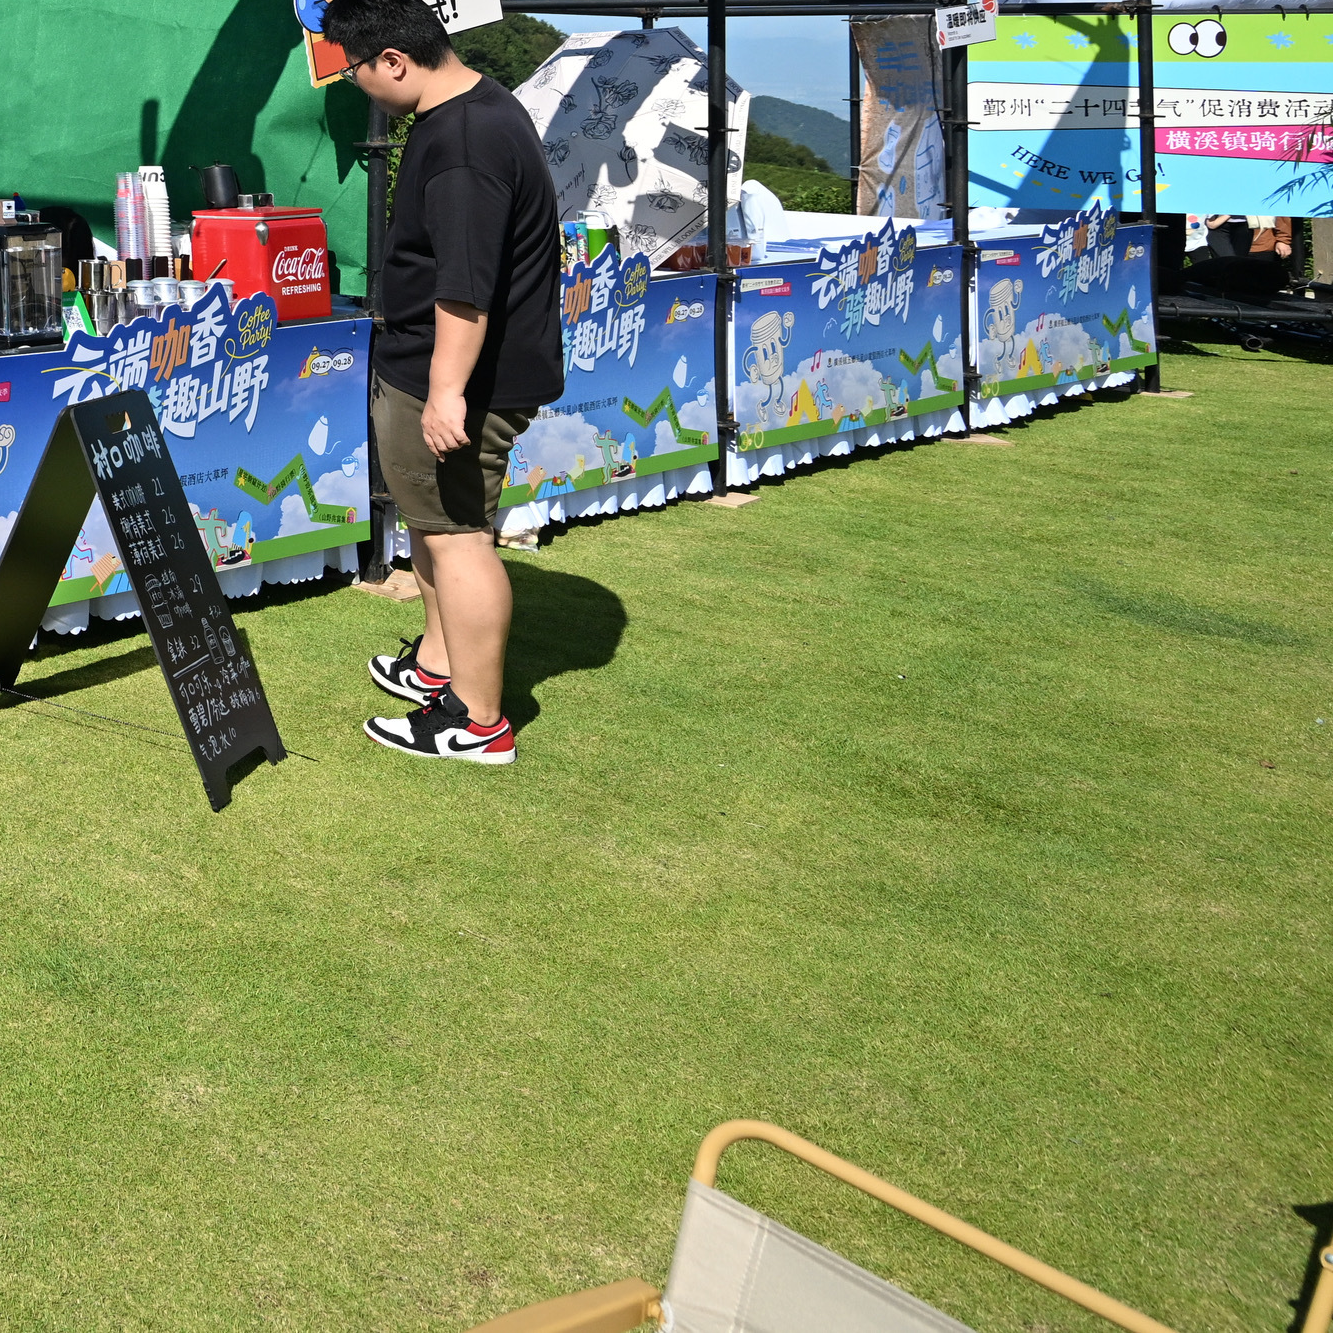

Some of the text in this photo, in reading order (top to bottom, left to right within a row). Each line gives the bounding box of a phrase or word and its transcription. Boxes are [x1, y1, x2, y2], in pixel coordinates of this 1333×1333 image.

[1011, 145, 1165, 185] HERE WE G!
[624, 262, 647, 284] Coffee
[811, 226, 895, 310] 云端咖香
[282, 283, 322, 295] REFRESHING
[560, 254, 616, 326] 咖香
[840, 269, 915, 341] 骑趣山野
[238, 307, 271, 332] Coffee
[240, 321, 272, 352] Party!
[311, 354, 353, 372] 09.27 09.28
[148, 356, 269, 439] 趣山野
[90, 424, 162, 481] 村口咖啡
[152, 477, 165, 496] 21
[161, 506, 176, 526] 26
[171, 532, 185, 550] 26
[189, 574, 204, 595] 29
